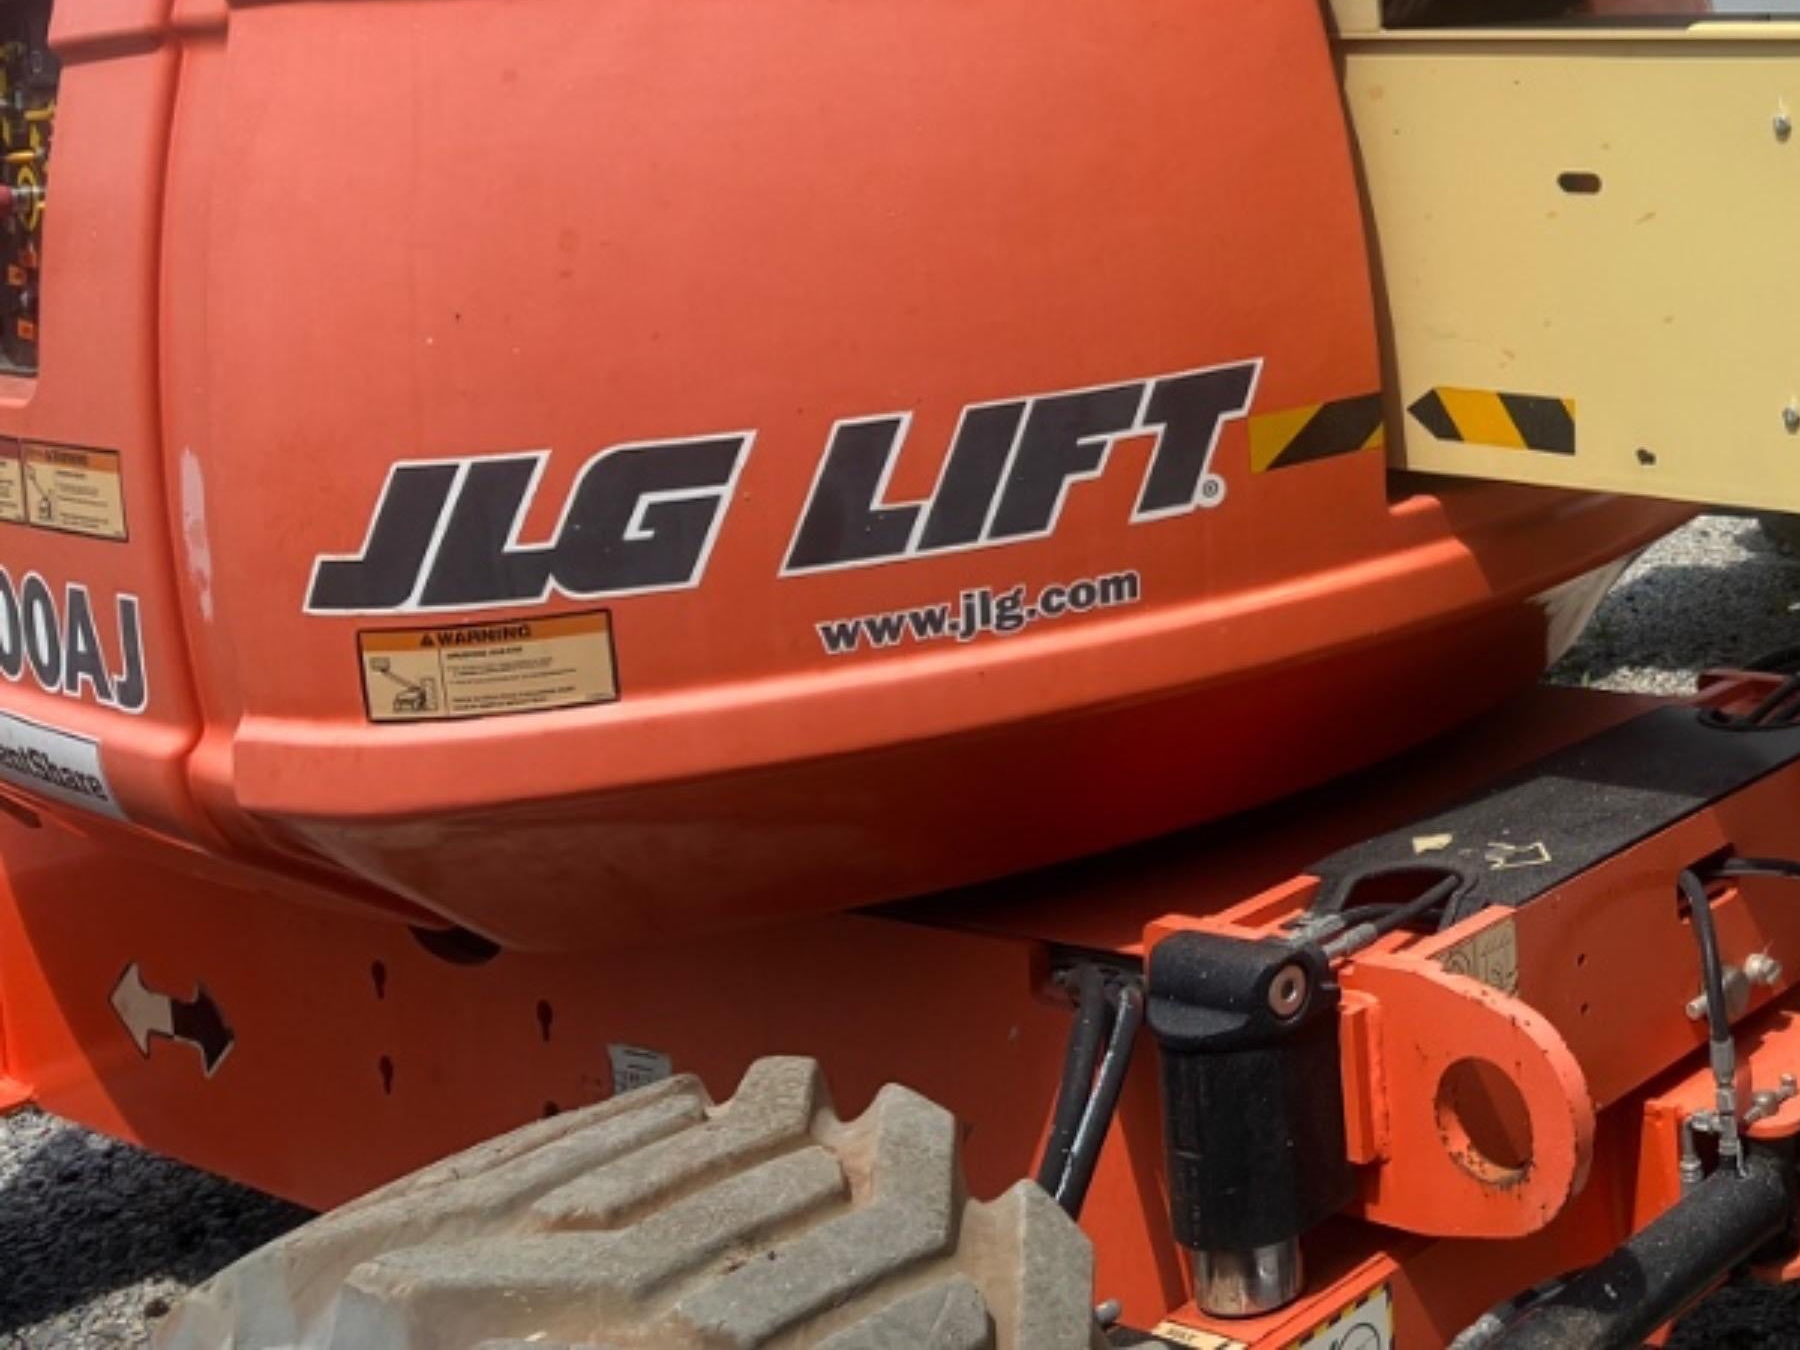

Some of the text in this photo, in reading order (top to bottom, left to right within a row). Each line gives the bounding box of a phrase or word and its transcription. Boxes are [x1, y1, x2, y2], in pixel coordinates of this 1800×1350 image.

[303, 357, 1263, 616] JLG LIFT
[437, 624, 533, 647] WARNING
[816, 569, 1140, 654] www.jlg.com
